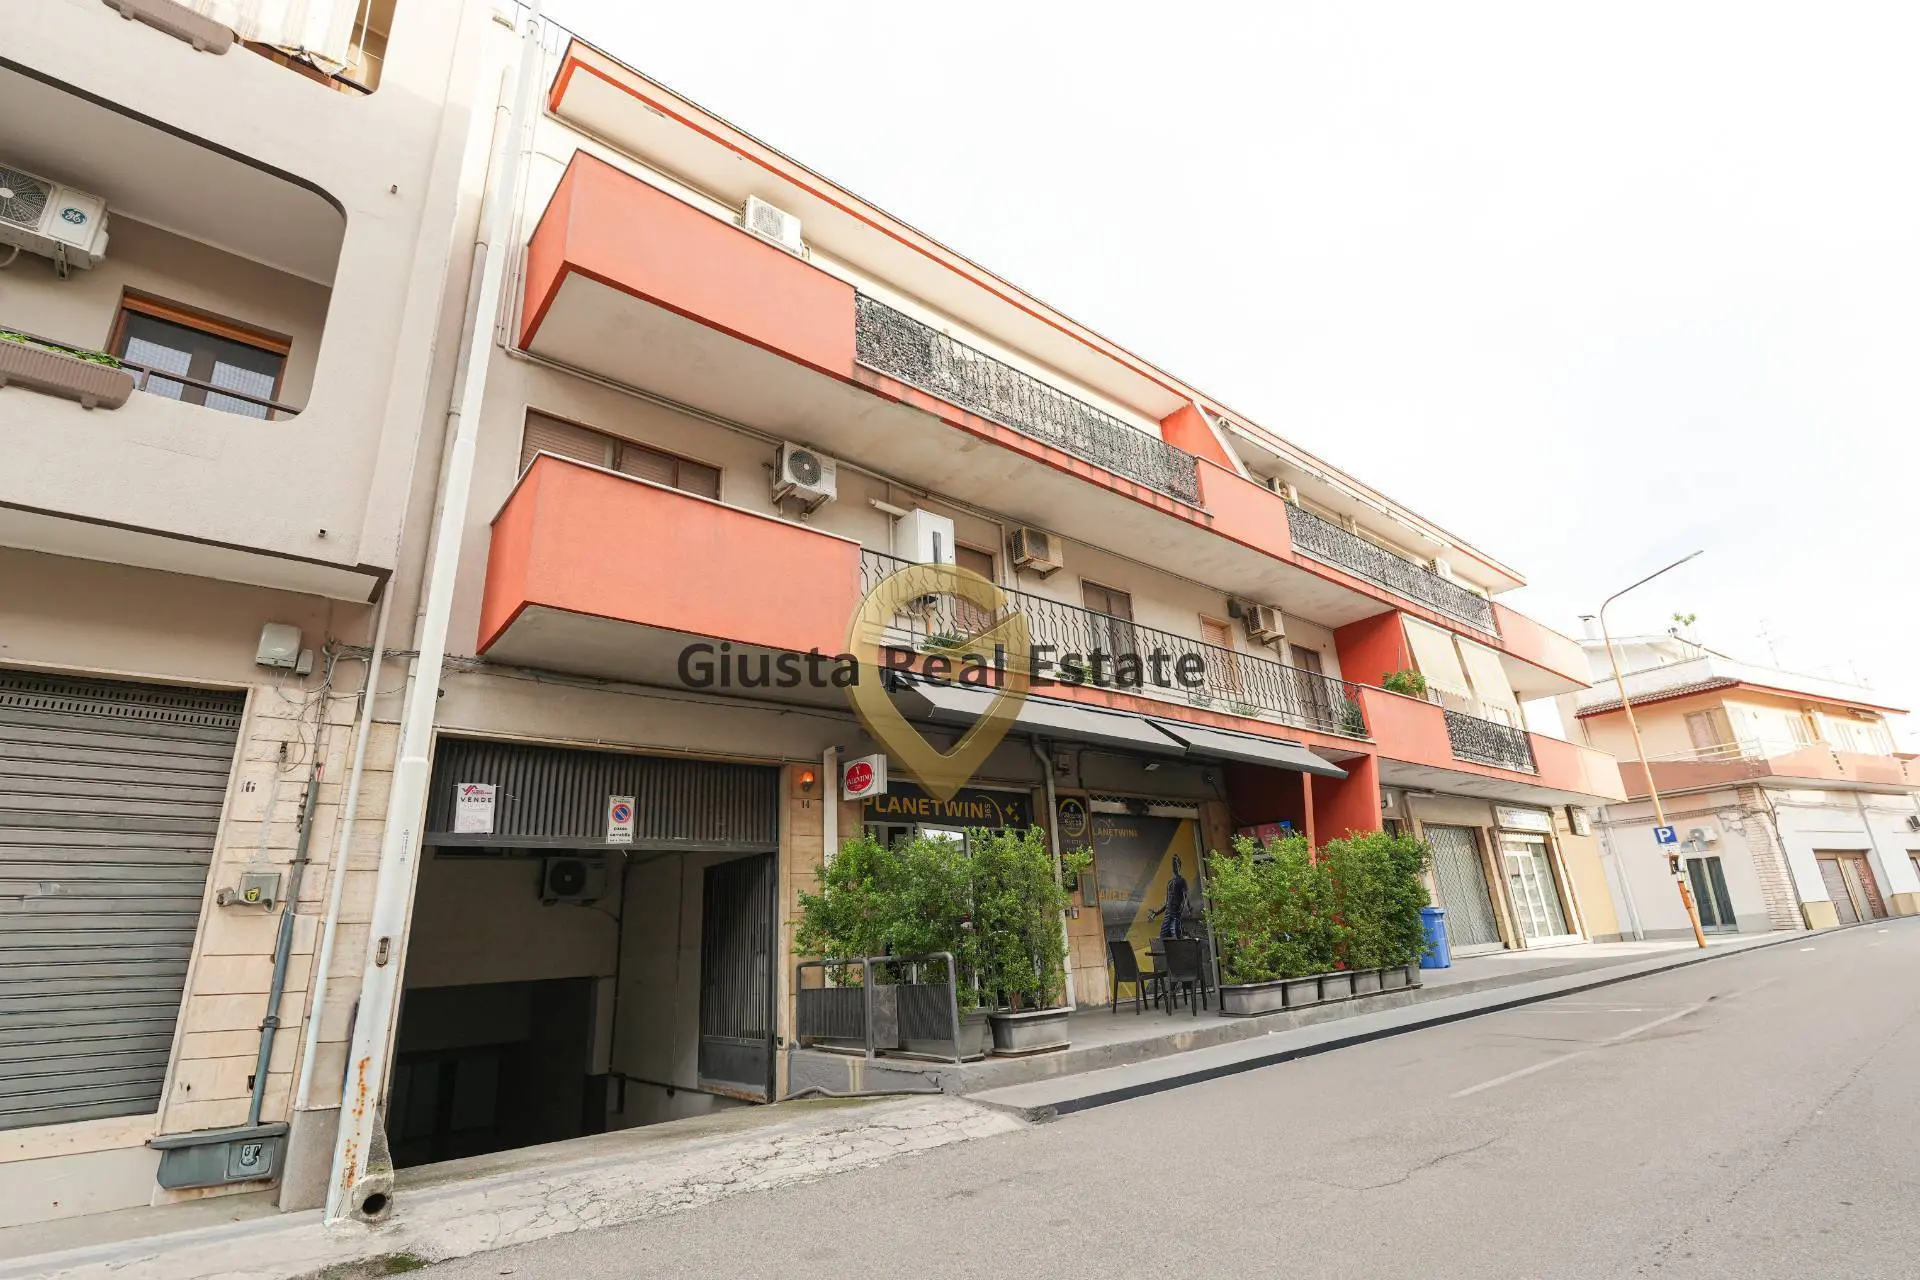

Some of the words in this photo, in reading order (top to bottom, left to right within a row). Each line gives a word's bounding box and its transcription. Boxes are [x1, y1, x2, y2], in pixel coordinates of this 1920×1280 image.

[802, 800, 810, 809] 14
[863, 795, 984, 819] PLANETWIN
[984, 803, 992, 819] 365
[1092, 827, 1135, 838] LANETWIN
[1657, 828, 1672, 843] P
